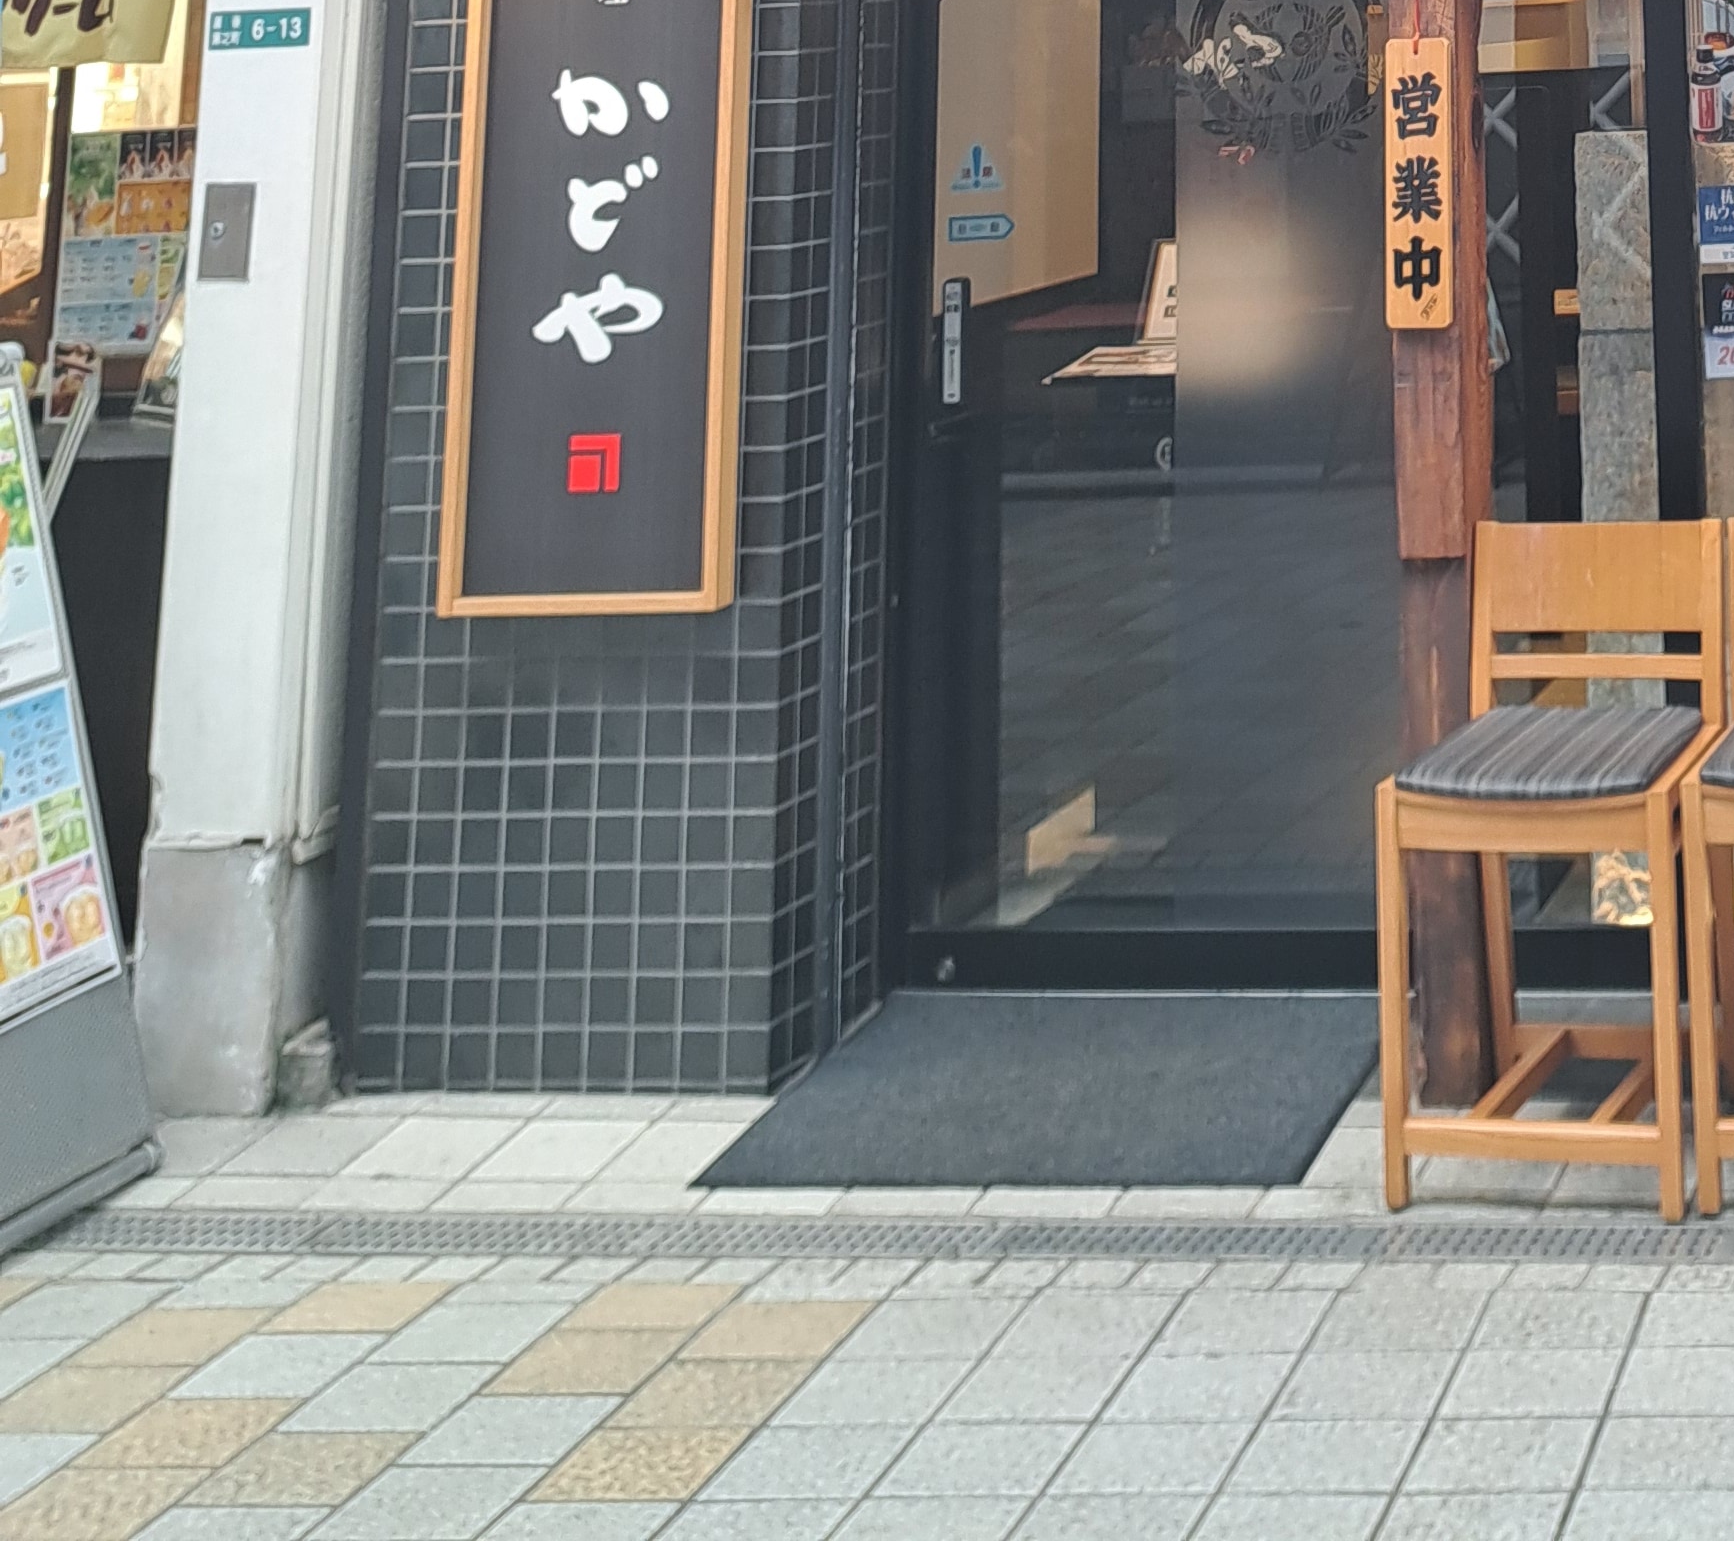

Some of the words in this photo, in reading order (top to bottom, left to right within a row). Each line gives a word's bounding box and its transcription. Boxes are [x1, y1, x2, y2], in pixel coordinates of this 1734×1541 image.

[251, 16, 302, 42] 6-13
[530, 67, 671, 365] かどや
[1391, 72, 1444, 301] 営業中
